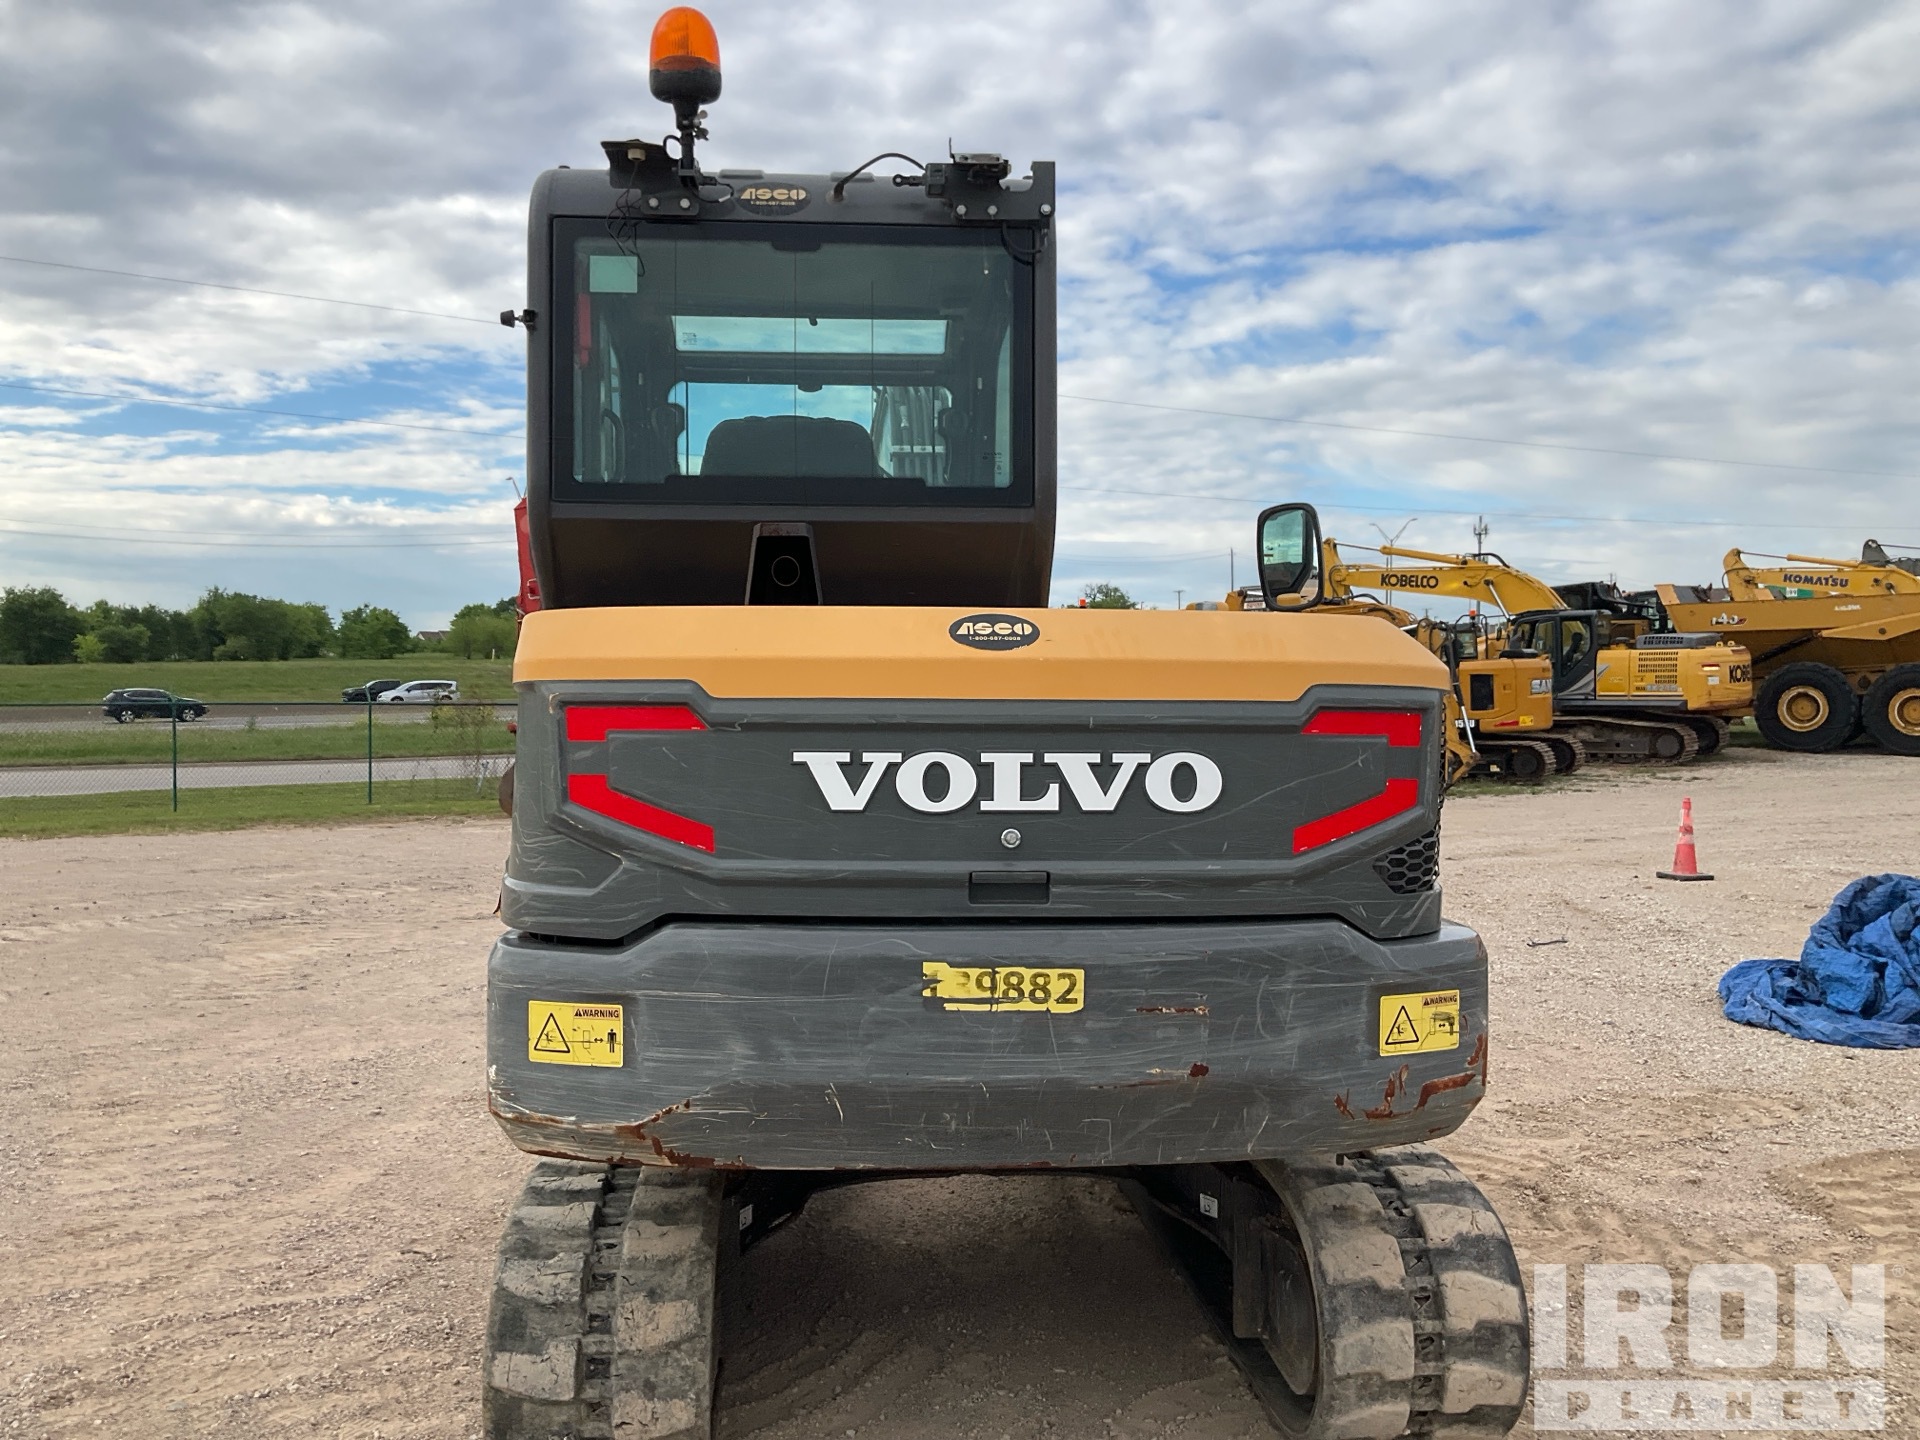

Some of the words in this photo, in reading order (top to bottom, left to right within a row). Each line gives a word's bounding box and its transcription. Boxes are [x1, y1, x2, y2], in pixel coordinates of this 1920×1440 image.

[741, 188, 807, 199] ASCO
[1380, 573, 1439, 589] KOBELCO
[1783, 573, 1849, 588] KOMATSU
[955, 622, 1032, 635] ASCO
[792, 752, 1223, 813] VOLVO
[1429, 994, 1458, 1005] WARNING
[582, 1009, 620, 1018] WARNING
